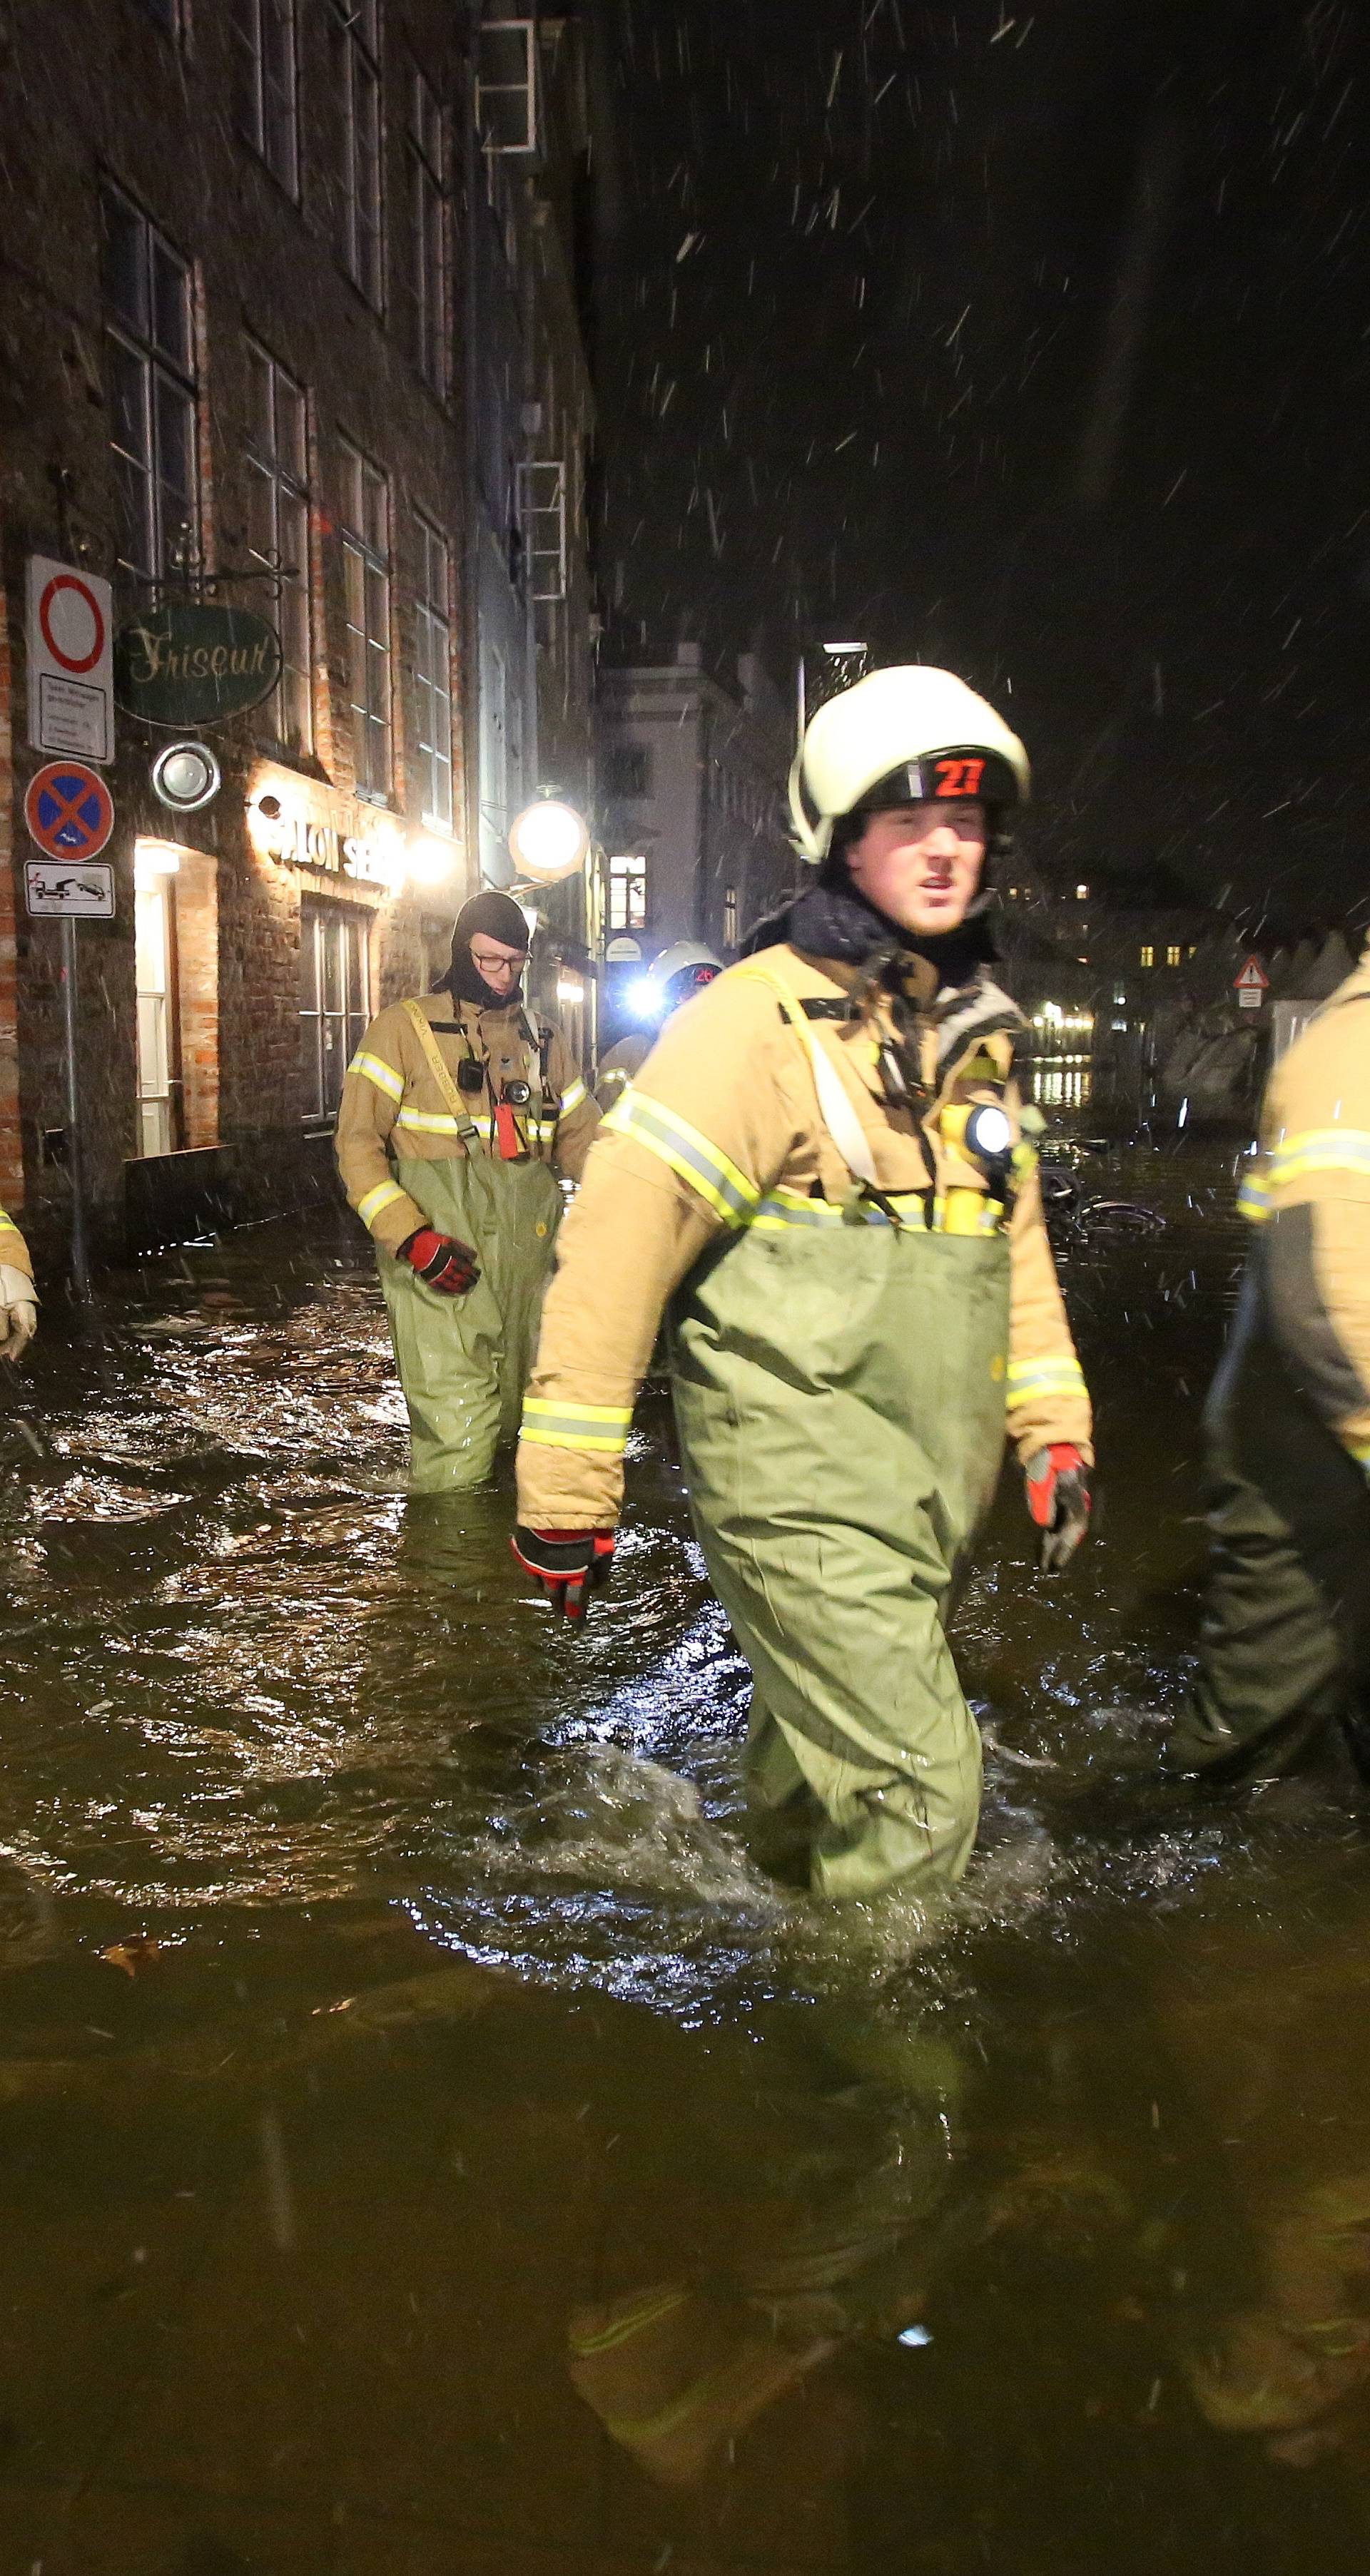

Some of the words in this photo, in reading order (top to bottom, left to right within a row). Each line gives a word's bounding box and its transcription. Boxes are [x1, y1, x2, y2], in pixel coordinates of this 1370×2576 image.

[128, 627, 269, 683] Friseur
[934, 758, 986, 797] 27
[696, 969, 714, 982] 26
